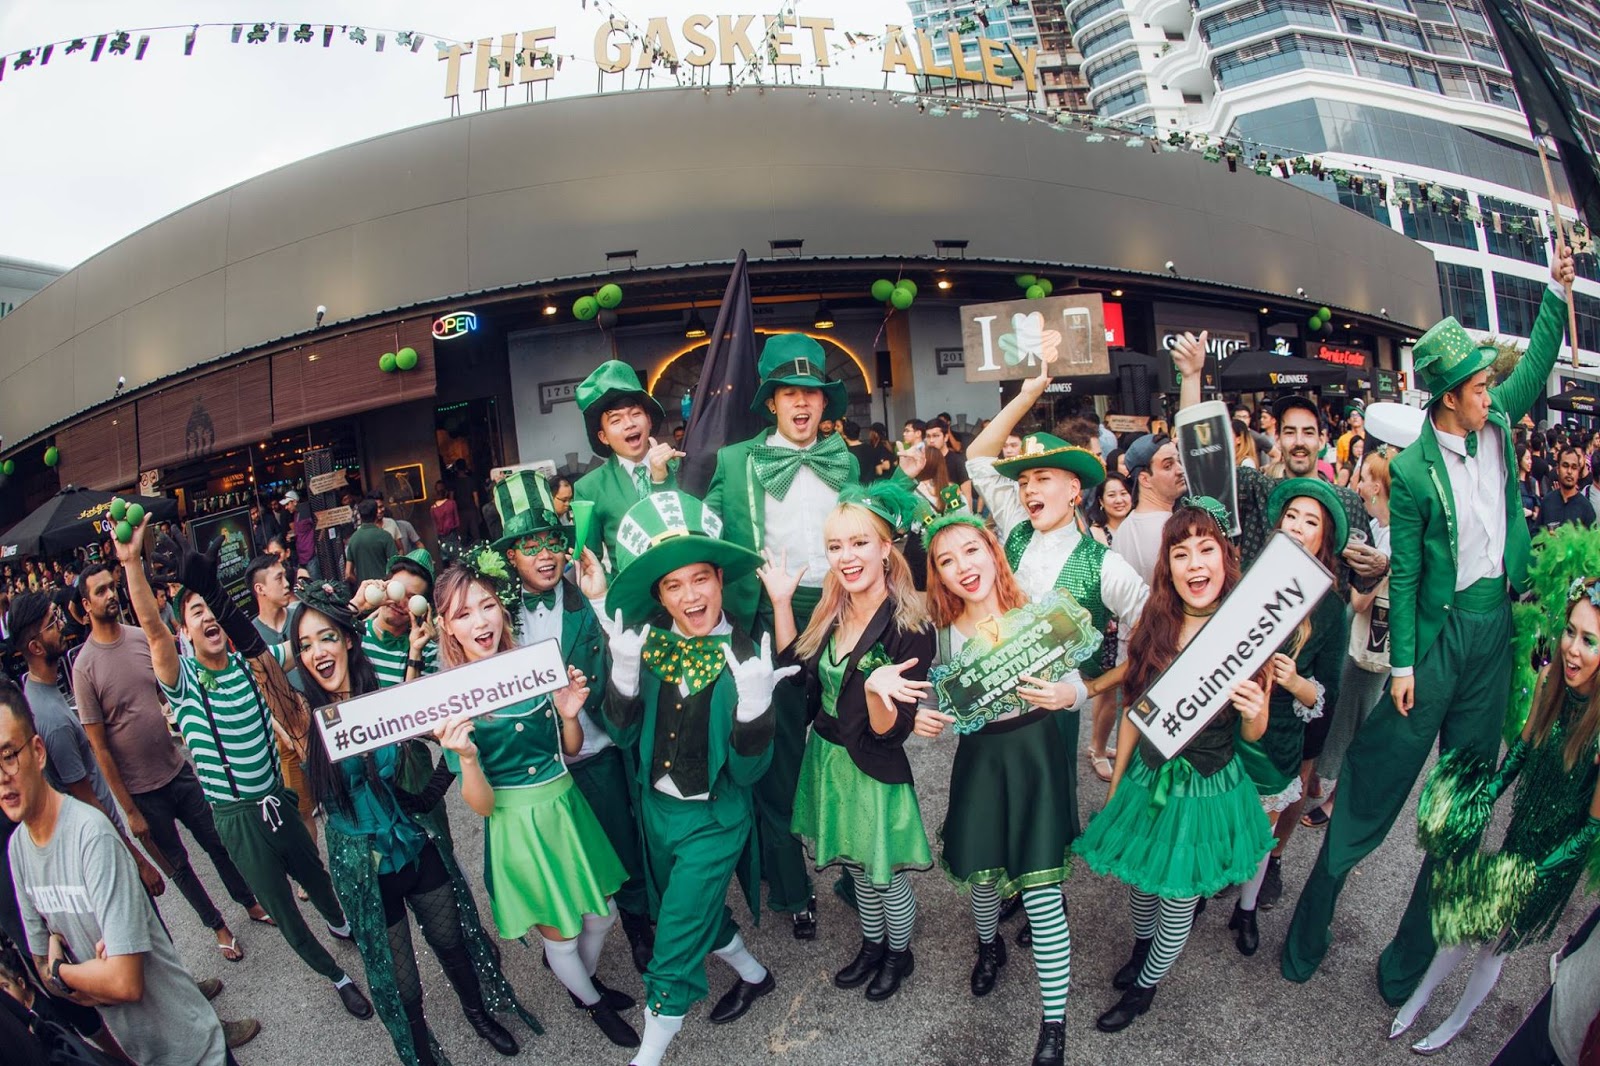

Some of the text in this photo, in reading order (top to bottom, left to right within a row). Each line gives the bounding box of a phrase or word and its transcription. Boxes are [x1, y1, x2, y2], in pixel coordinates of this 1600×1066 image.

[437, 14, 1038, 98] THE GASKET ALLEY
[432, 316, 477, 334] OPEN
[973, 315, 1001, 372] I
[1277, 373, 1309, 384] GUINNESS
[1319, 346, 1344, 364] Service
[1190, 443, 1222, 457] GUINNESS
[959, 620, 1053, 688] ST. PATRICK'S
[980, 642, 1050, 692] FESTIVAL
[1161, 576, 1306, 739] #GuinnessMy
[333, 666, 558, 751] #GuinnessStPatricks
[978, 686, 1003, 707] LET'S
[1001, 675, 1020, 692] GET
